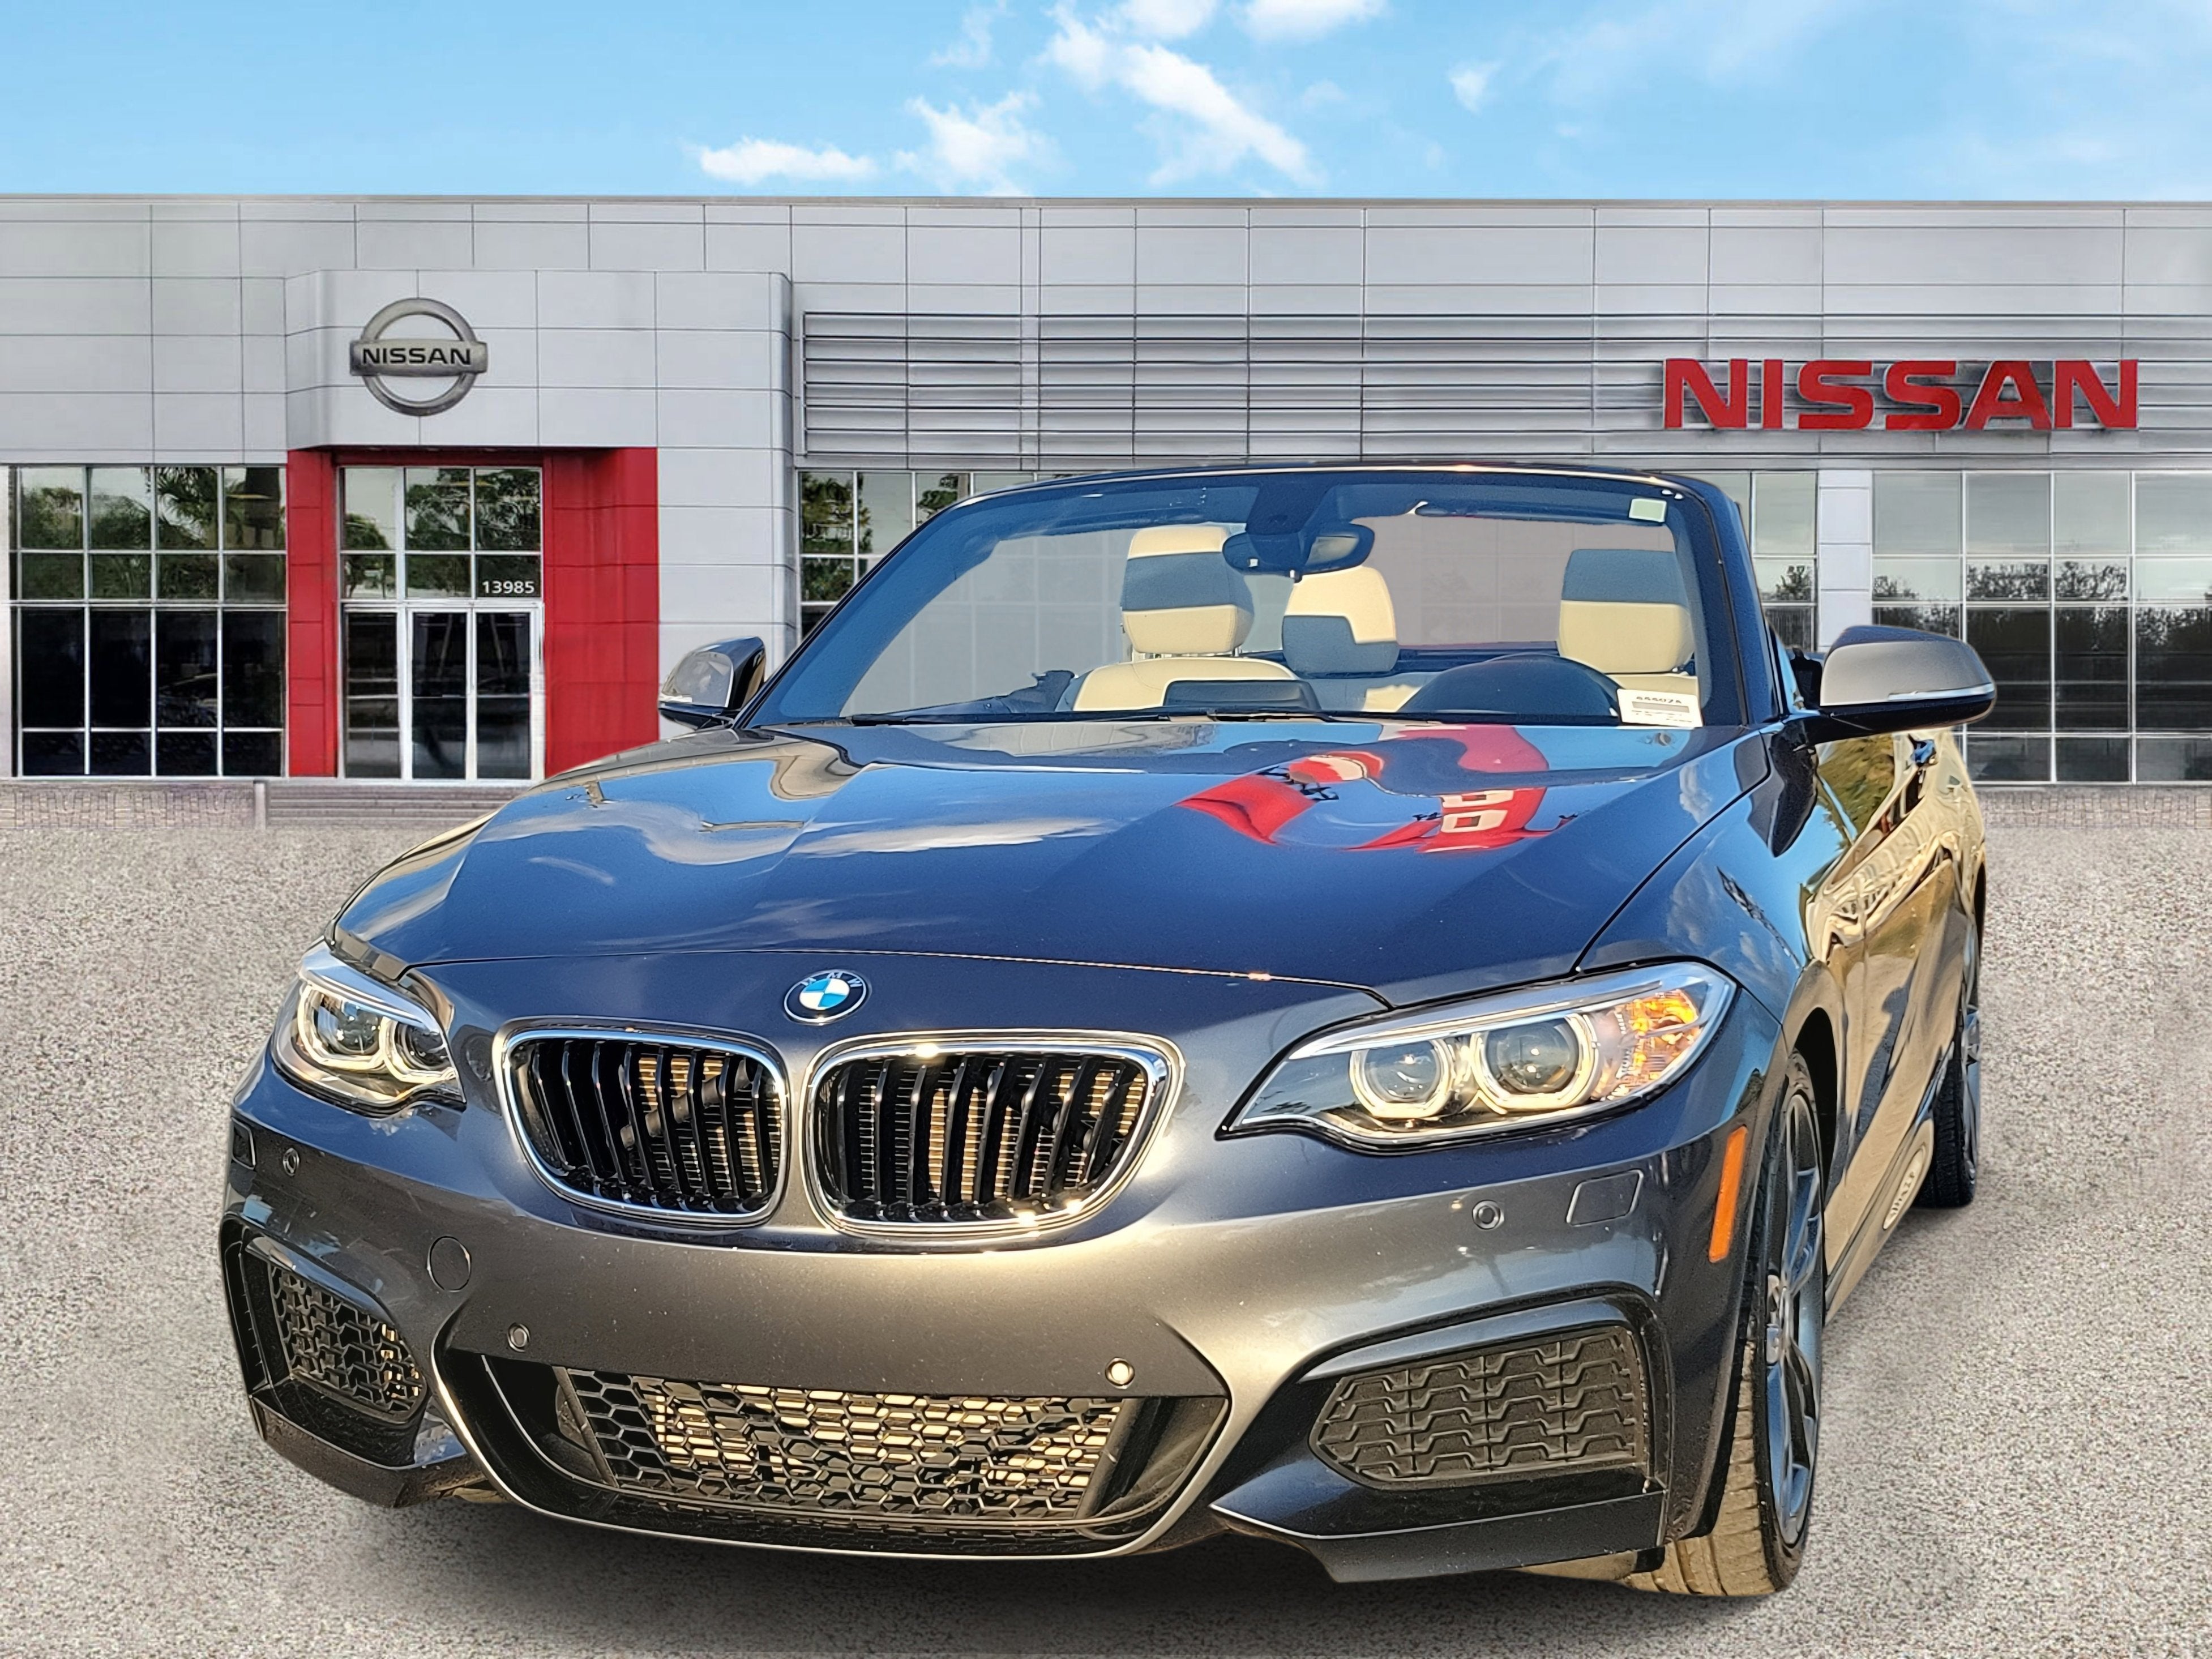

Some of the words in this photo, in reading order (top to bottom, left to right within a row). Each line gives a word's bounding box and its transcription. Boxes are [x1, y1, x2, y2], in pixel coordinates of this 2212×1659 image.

[362, 347, 471, 366] NISSAN
[1663, 358, 2140, 431] NISSAN
[482, 580, 534, 594] 13985
